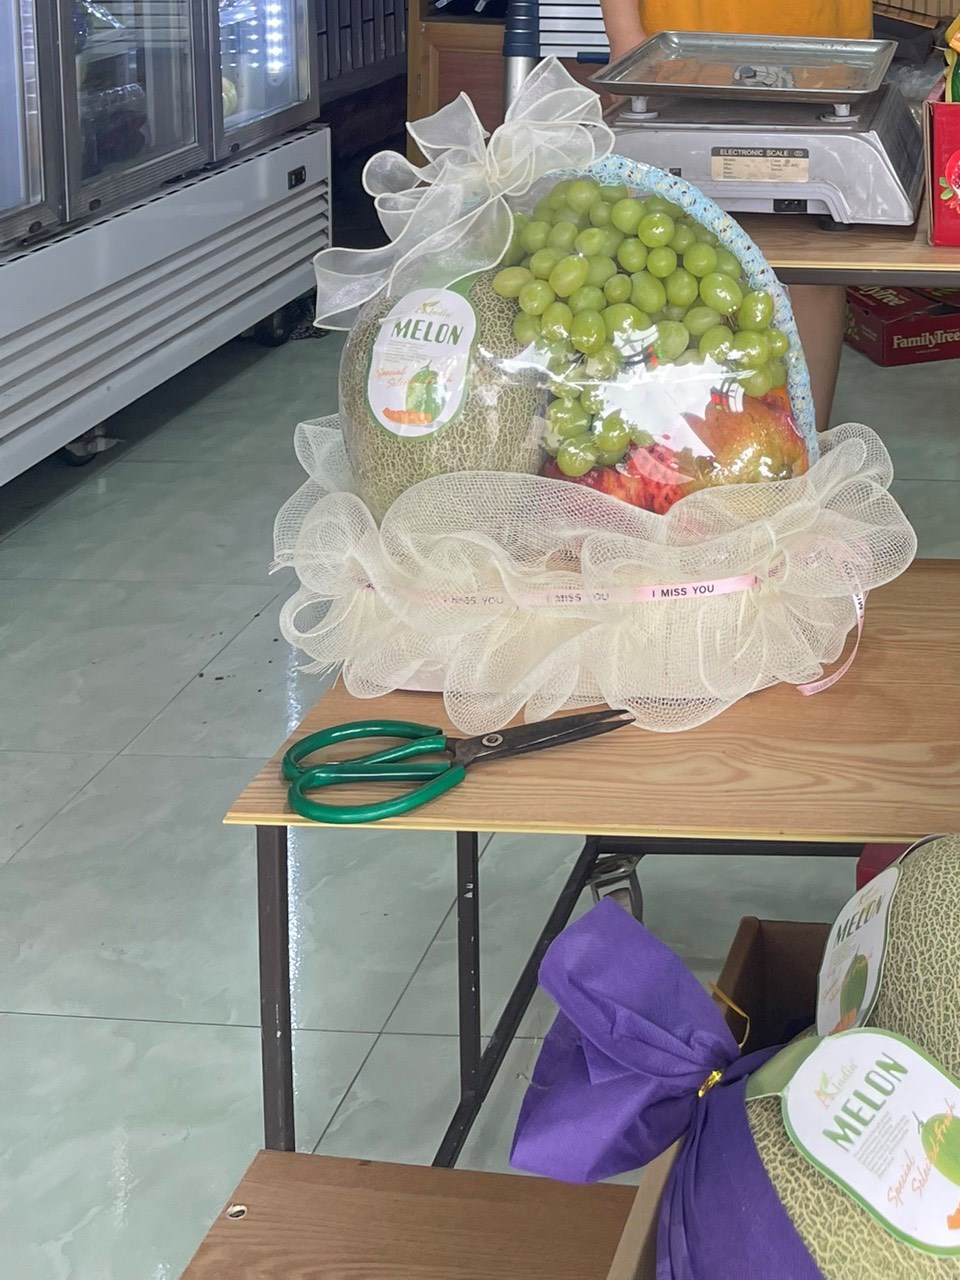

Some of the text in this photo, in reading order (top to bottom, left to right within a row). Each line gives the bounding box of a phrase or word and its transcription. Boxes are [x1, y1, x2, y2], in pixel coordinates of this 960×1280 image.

[720, 148, 763, 156] ELECTRONIC
[391, 318, 464, 346] MELON
[893, 330, 960, 349] FamilyTree
[660, 587, 687, 597] MISS
[693, 584, 715, 594] YOU
[822, 1052, 908, 1152] MELON
[887, 1148, 916, 1208] Special
